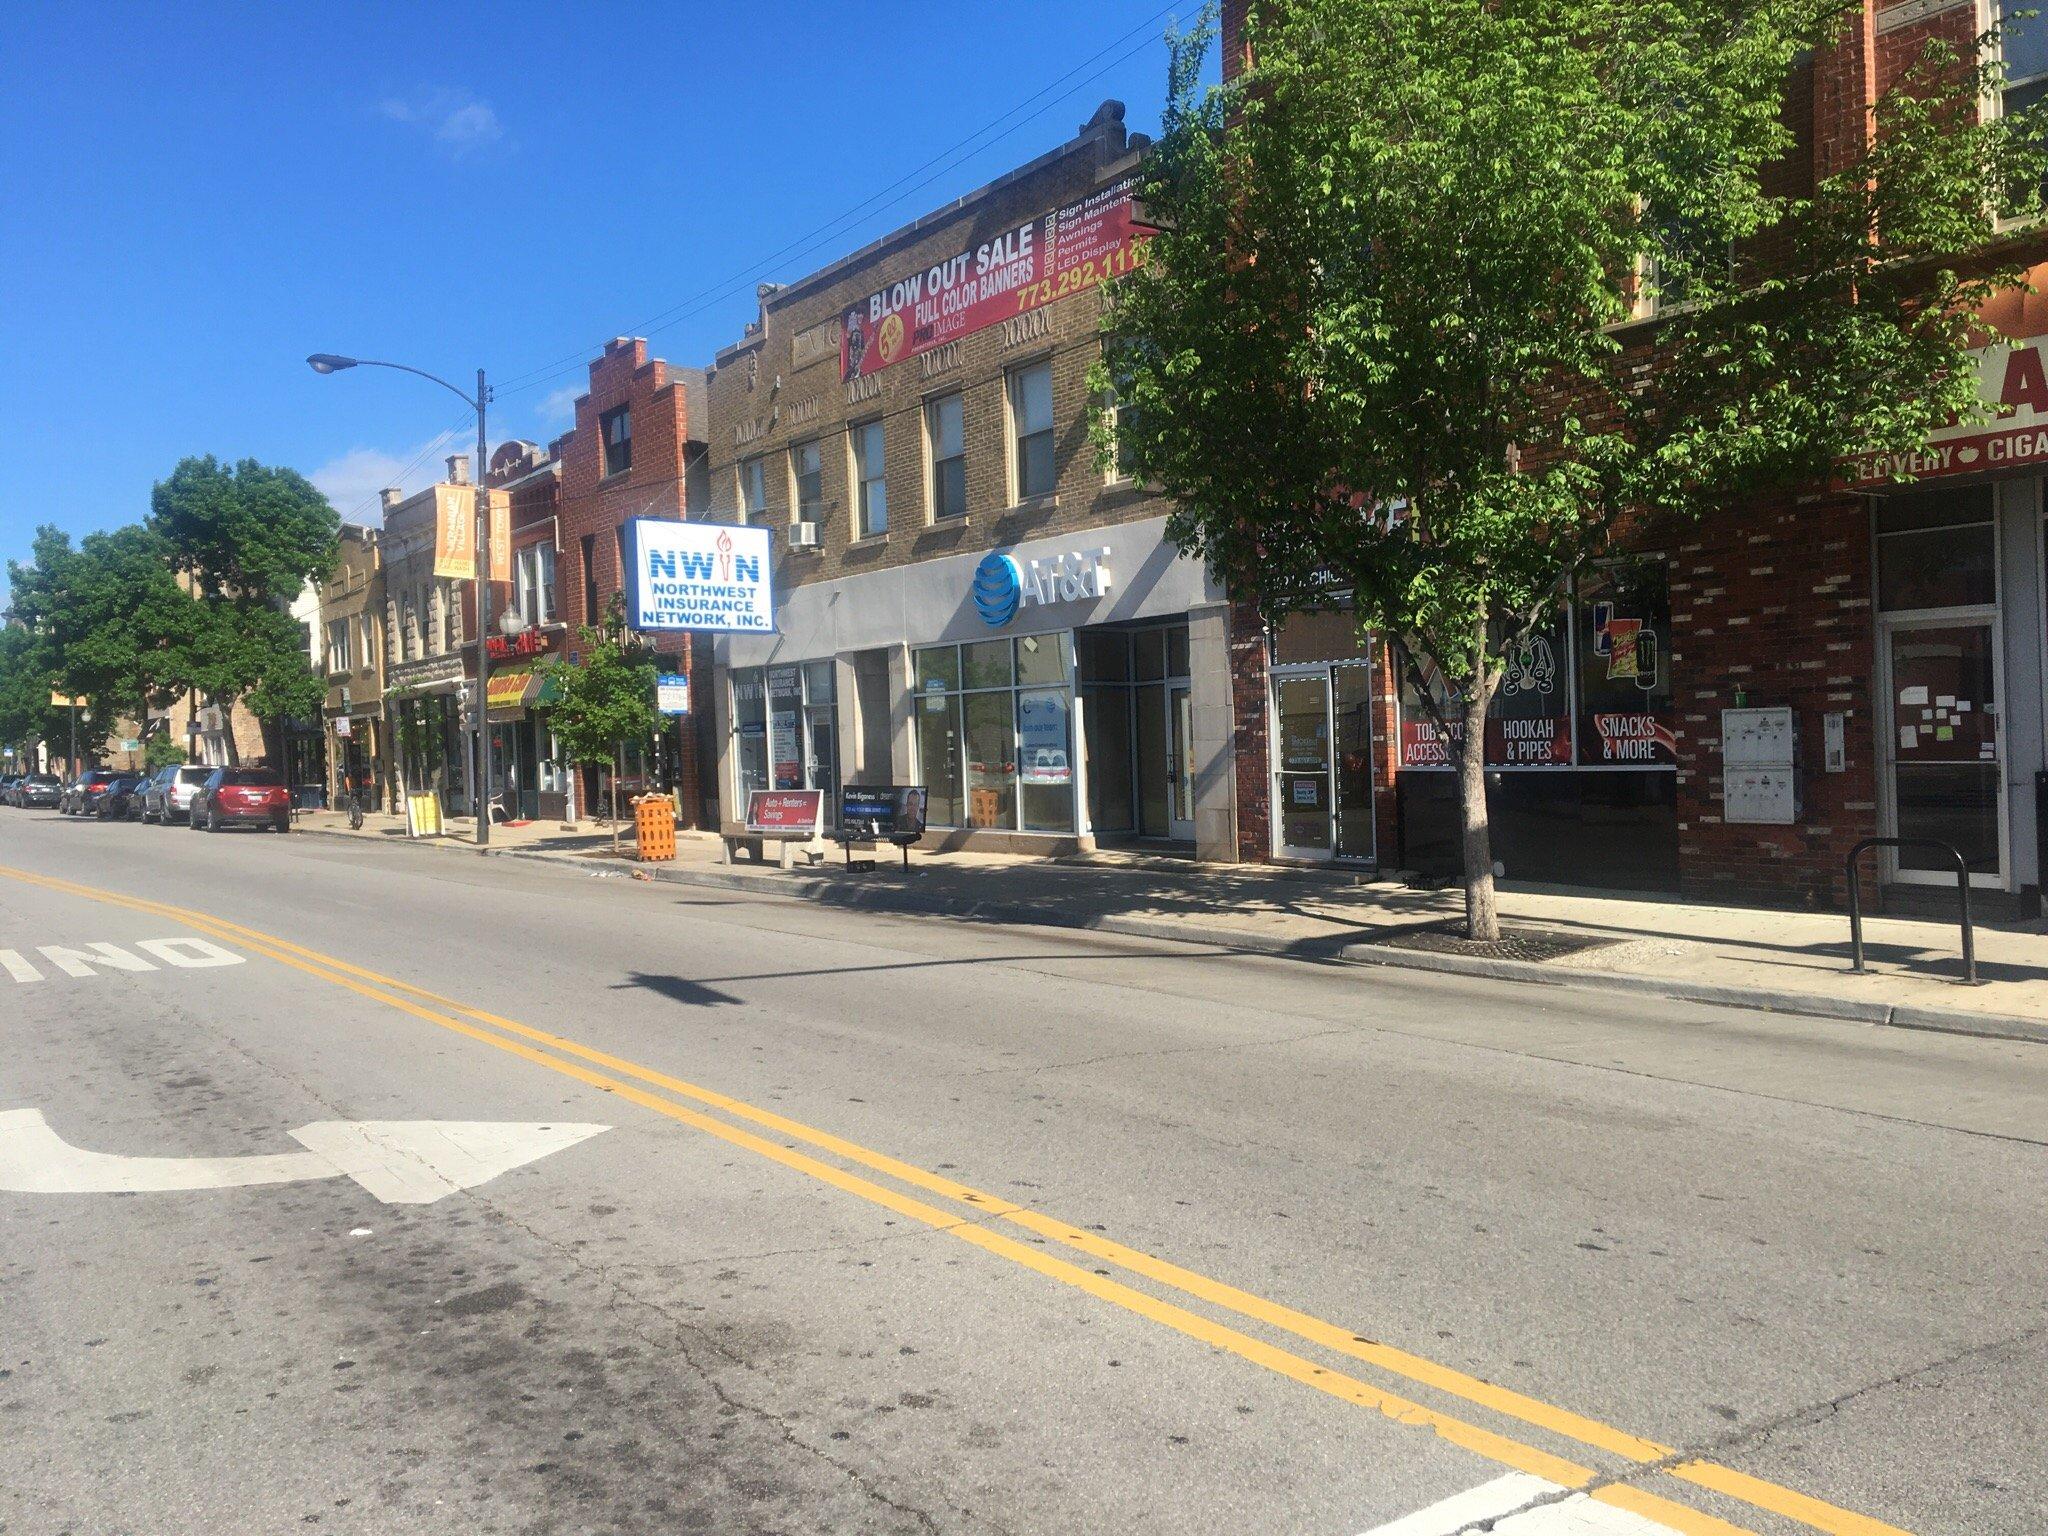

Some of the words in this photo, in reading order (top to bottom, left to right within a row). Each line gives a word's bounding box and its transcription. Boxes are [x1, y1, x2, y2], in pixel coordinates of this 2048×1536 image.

[1058, 203, 1082, 220] Sign
[1085, 174, 1145, 208] Installation
[1058, 217, 1082, 233] Sign
[1058, 219, 1103, 246] Awnings
[1058, 235, 1098, 258] Permits
[1058, 255, 1079, 271] LED
[1081, 237, 1122, 268] Display
[869, 273, 923, 323] BLOW
[927, 251, 971, 296] OUT
[976, 222, 1034, 275] SALE
[915, 295, 939, 328] FULL
[942, 280, 978, 316] COLOR
[980, 255, 1034, 301] BANNERS
[1855, 445, 1954, 480] ELIVERY
[1019, 547, 1112, 609] AT&T
[653, 582, 756, 598] NORTHWEST
[657, 597, 754, 612] INSURANCE
[642, 611, 732, 628] NETWORK,
[736, 614, 769, 628] INC.
[1415, 722, 1464, 741] TOBCO
[1503, 719, 1554, 739] HOOKAH
[1601, 717, 1656, 738] SNACKS
[1406, 743, 1451, 761] ACCESS
[1507, 741, 1515, 760] &
[1518, 740, 1552, 760] PIPES
[1603, 741, 1612, 760] &
[1616, 739, 1656, 760] MORE
[765, 797, 777, 808] Auto
[782, 797, 803, 808] Renters
[763, 809, 783, 821] Savings
